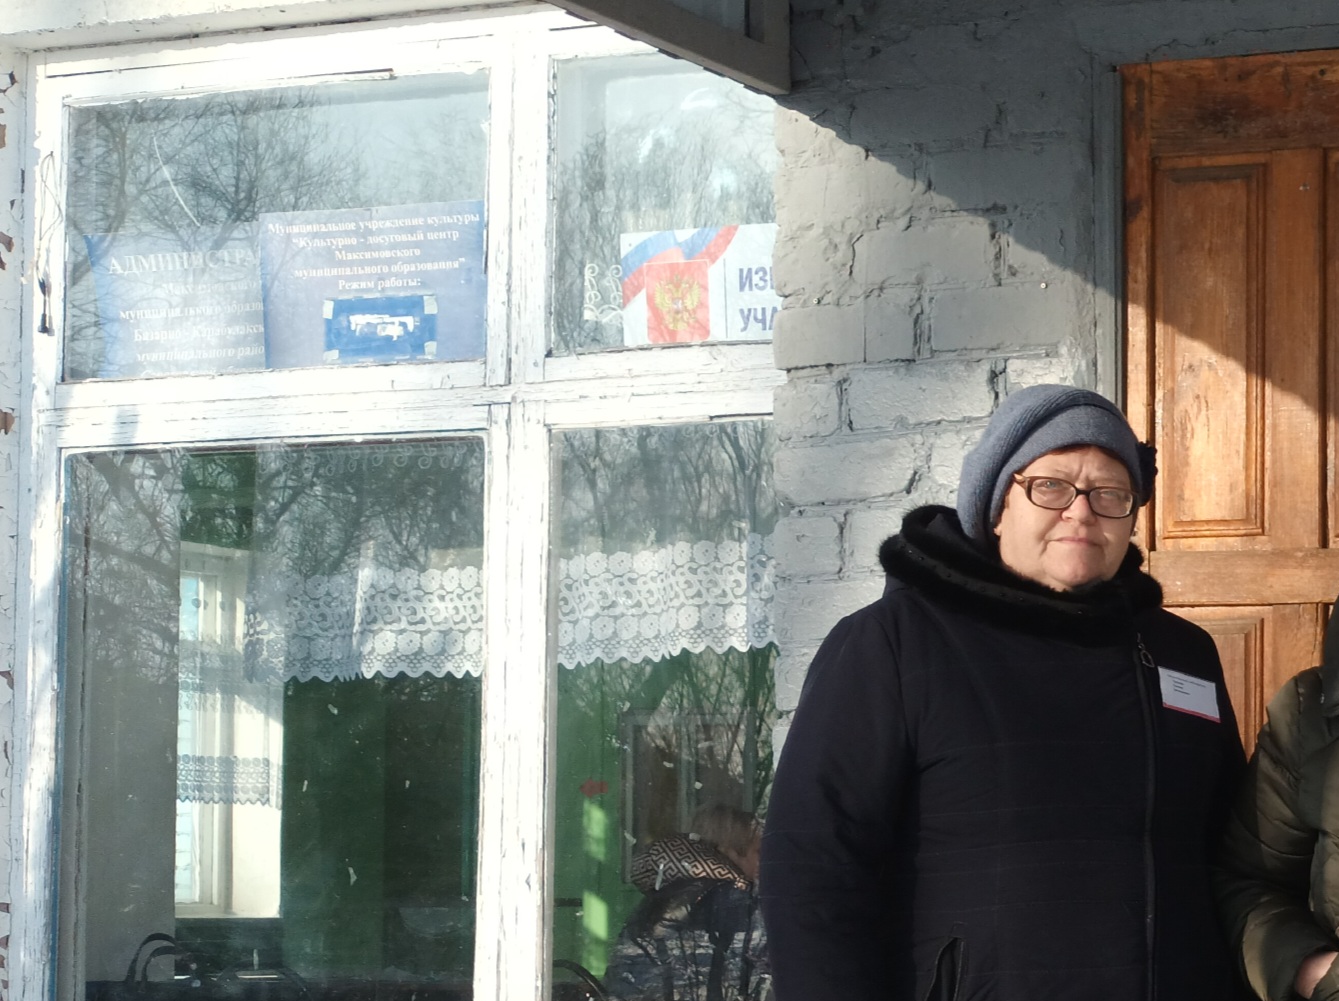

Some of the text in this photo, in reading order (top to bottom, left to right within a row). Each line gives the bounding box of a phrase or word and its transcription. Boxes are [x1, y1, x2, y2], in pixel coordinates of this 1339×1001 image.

[359, 217, 424, 232] учреждение
[427, 213, 480, 227] культуры
[366, 230, 424, 245] досуговый
[426, 230, 459, 242] центр
[335, 248, 421, 261] Максимовского
[294, 264, 389, 280] муниципального
[338, 277, 421, 291] Режим работы:
